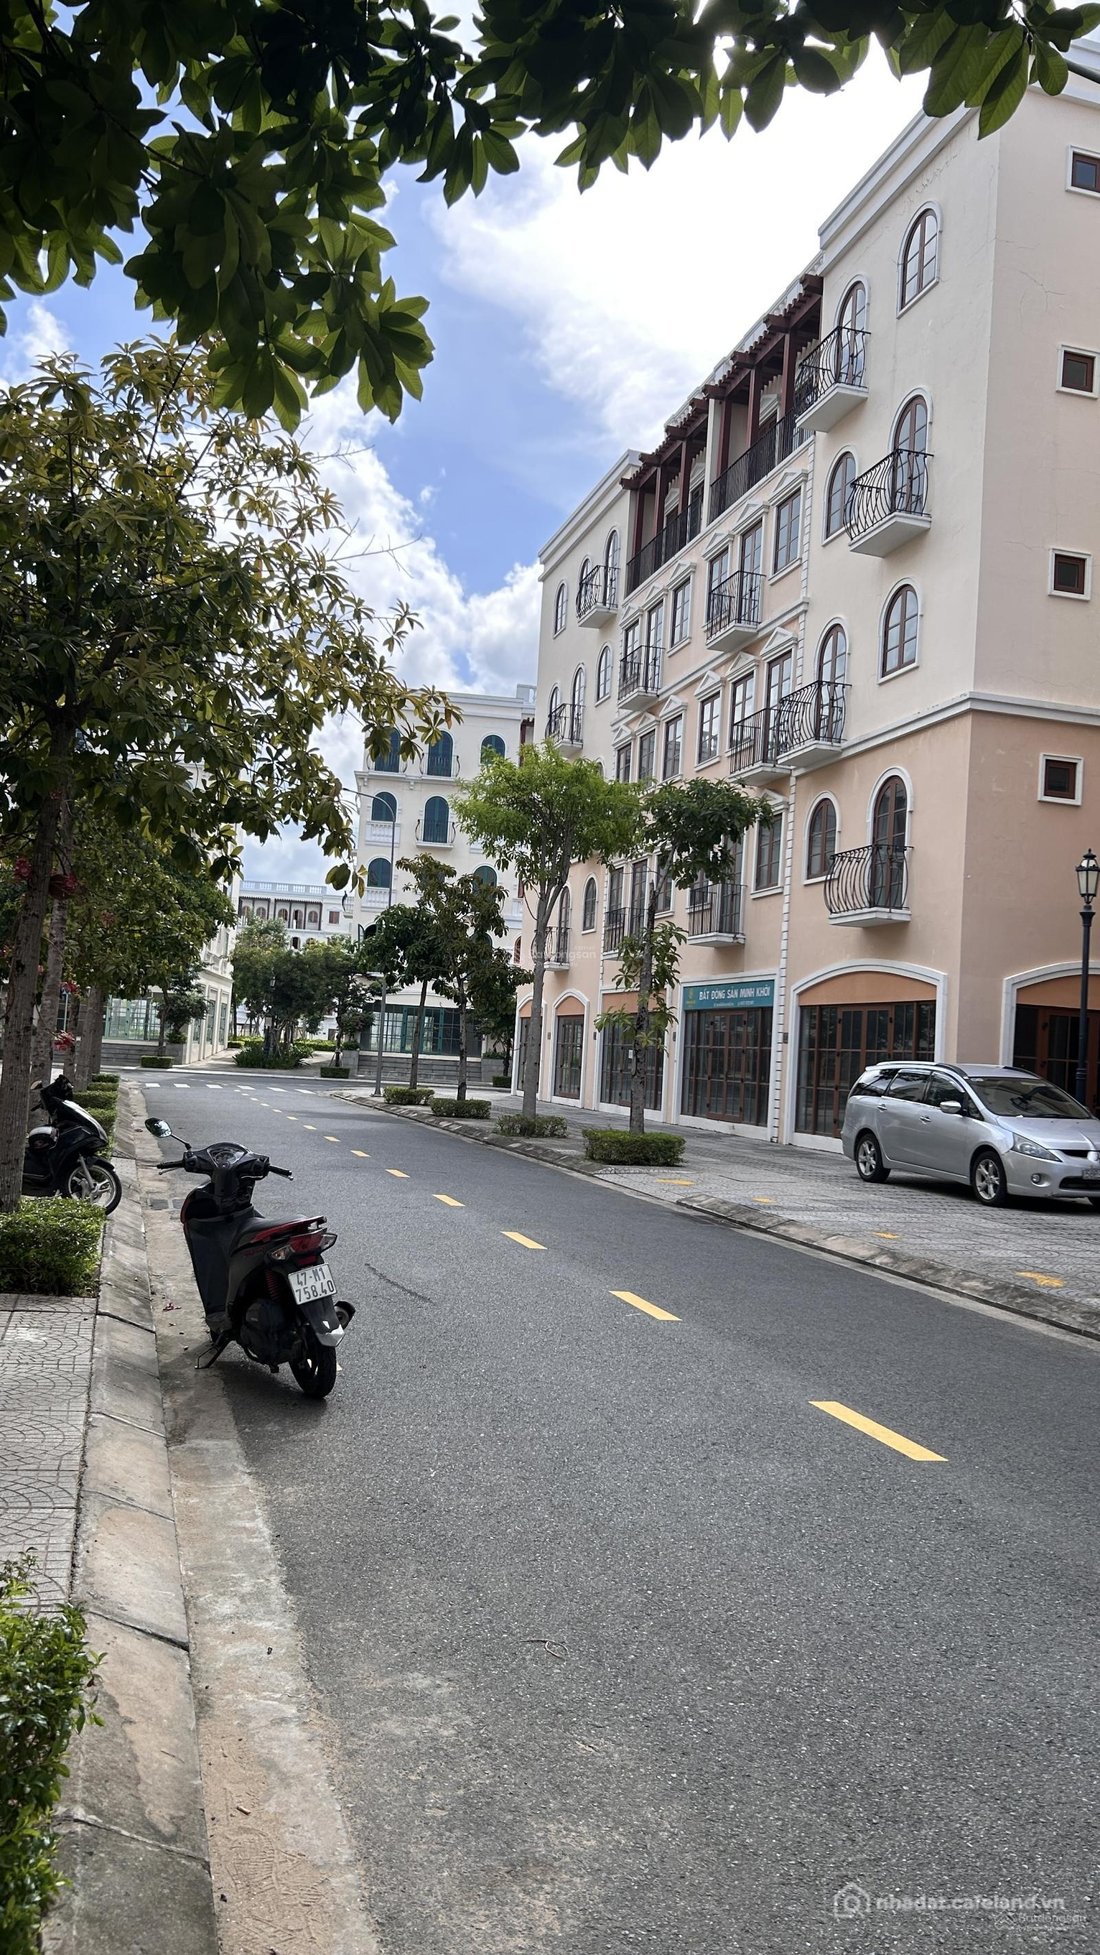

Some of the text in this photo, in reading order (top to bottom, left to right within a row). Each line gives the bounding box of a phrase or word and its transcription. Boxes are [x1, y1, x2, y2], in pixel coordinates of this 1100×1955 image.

[739, 987, 755, 998] MINH
[296, 1267, 326, 1286] 47-M1
[295, 1280, 335, 1302] 758.40
